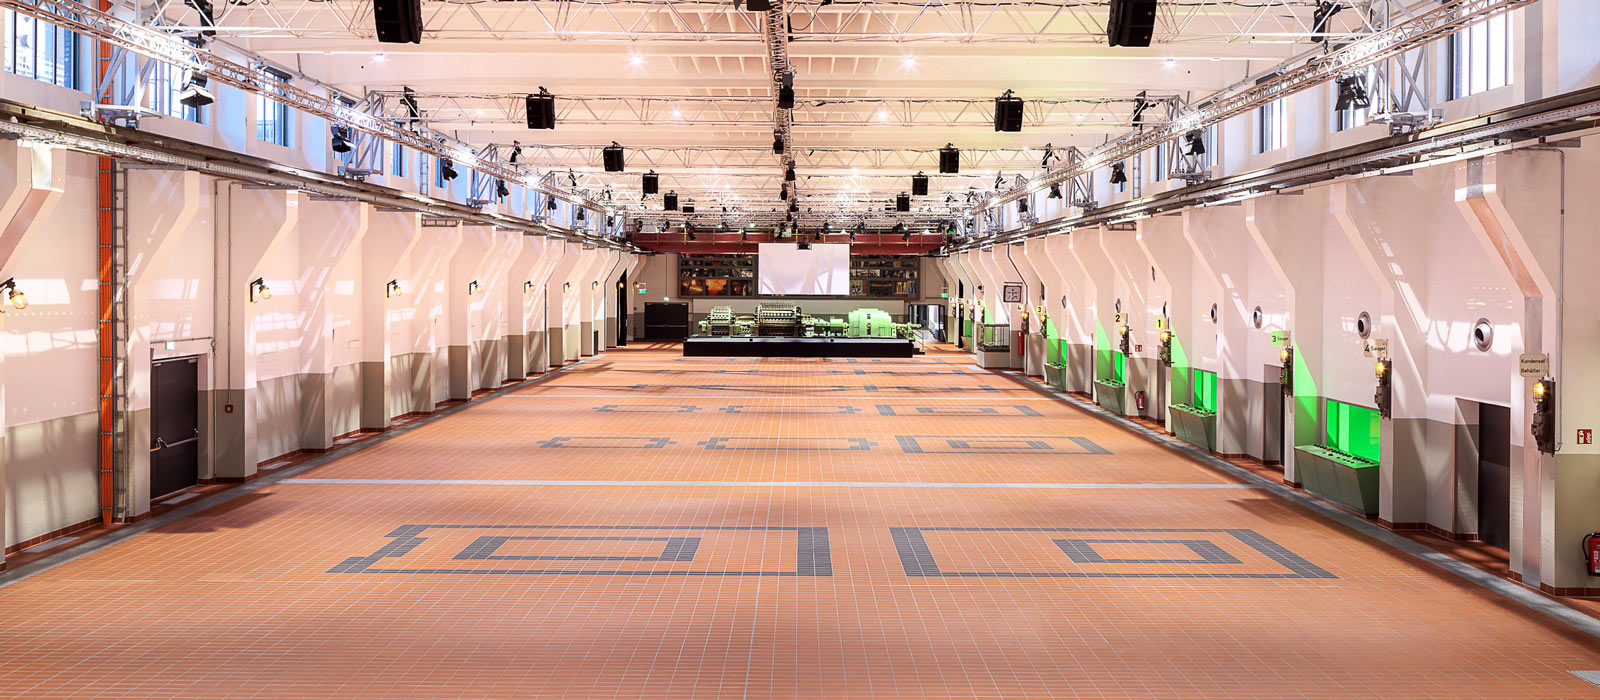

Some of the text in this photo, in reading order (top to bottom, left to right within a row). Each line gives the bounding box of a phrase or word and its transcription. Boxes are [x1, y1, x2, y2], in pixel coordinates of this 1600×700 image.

[1115, 314, 1121, 323] 2
[1272, 335, 1277, 343] 3
[1364, 344, 1370, 352] 4
